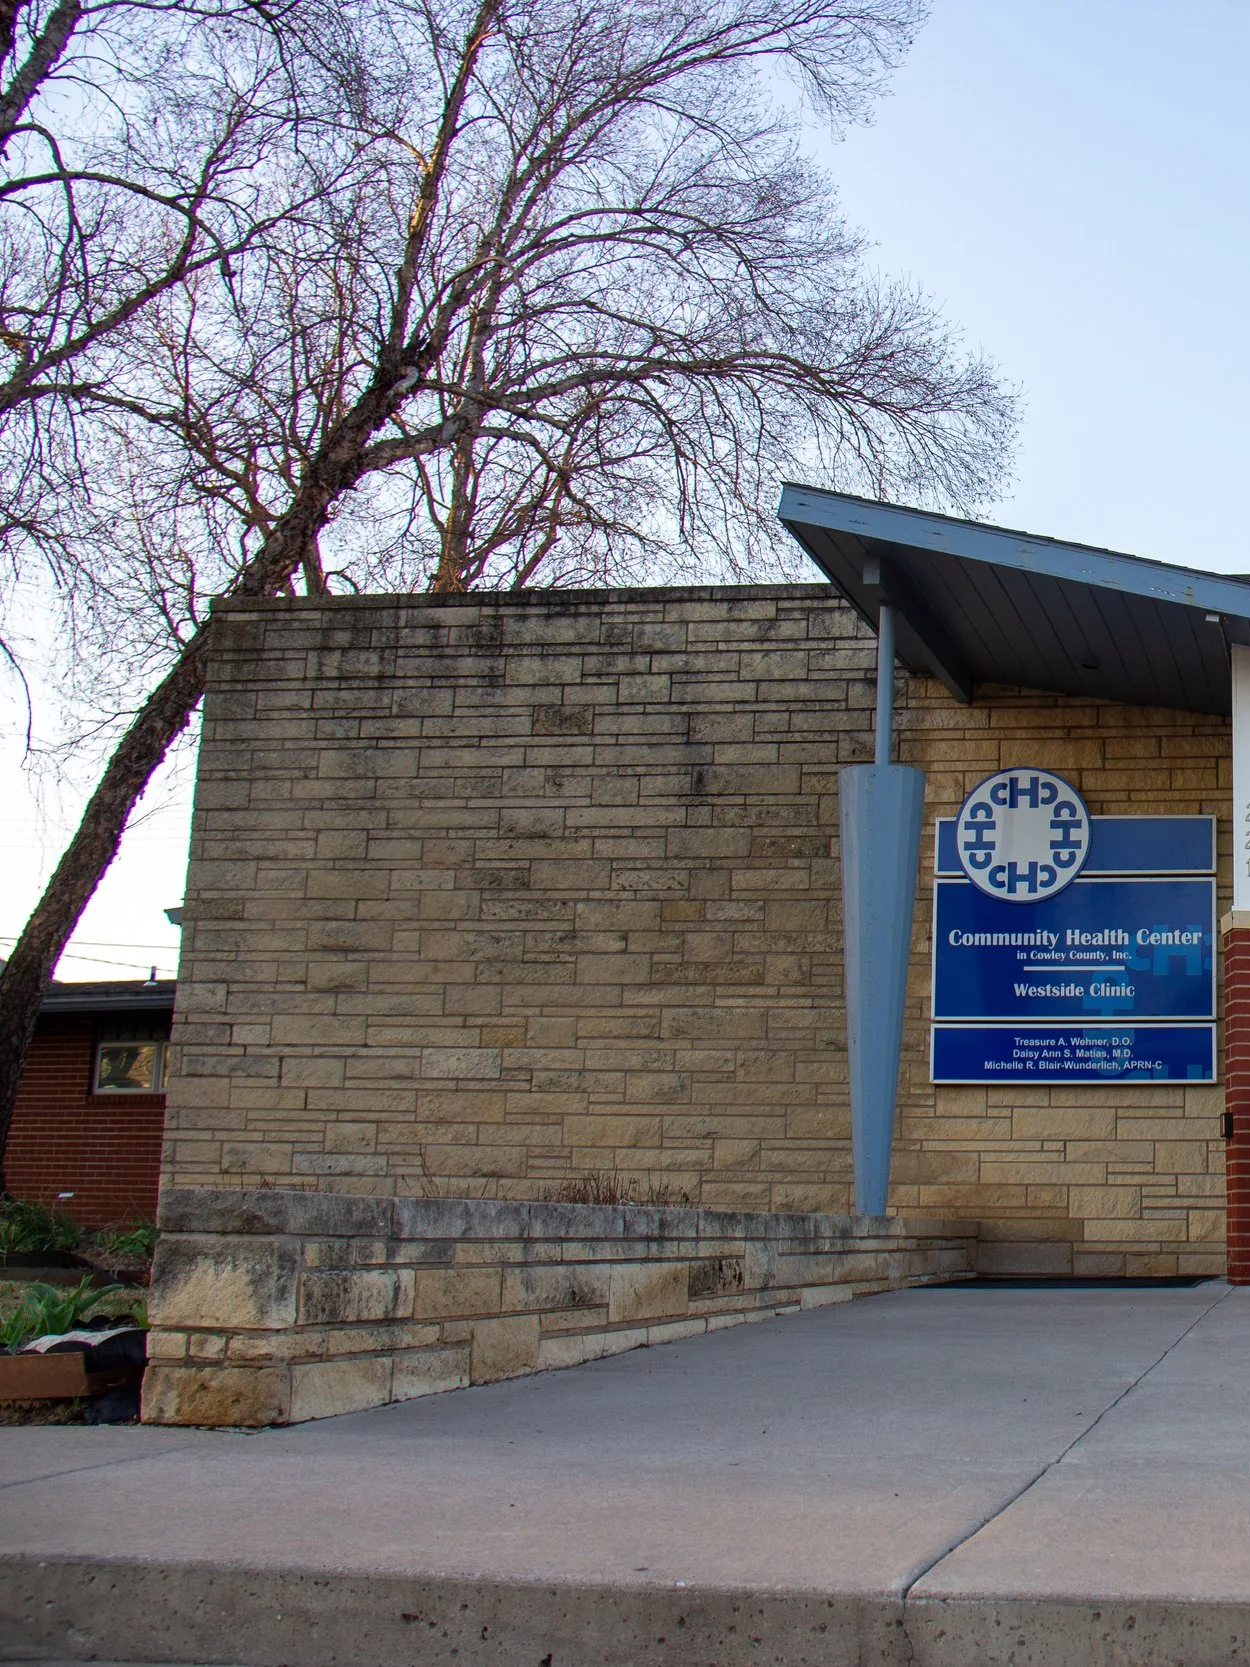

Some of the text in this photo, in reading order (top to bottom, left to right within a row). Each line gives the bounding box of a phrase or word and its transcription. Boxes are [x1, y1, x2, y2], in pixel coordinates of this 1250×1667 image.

[948, 928, 1202, 949] Community Health Center
[1016, 950, 1132, 961] in Cowley County, Inc.
[1014, 982, 1135, 997] Westside Clinic
[1014, 1037, 1133, 1048] Treasure A. Wehner, D.O.
[1012, 1049, 1134, 1059] Daisy Ann S. Matias, M.D.
[984, 1060, 1163, 1071] Michelle R. Blair-Wunderlich, APRN-C
